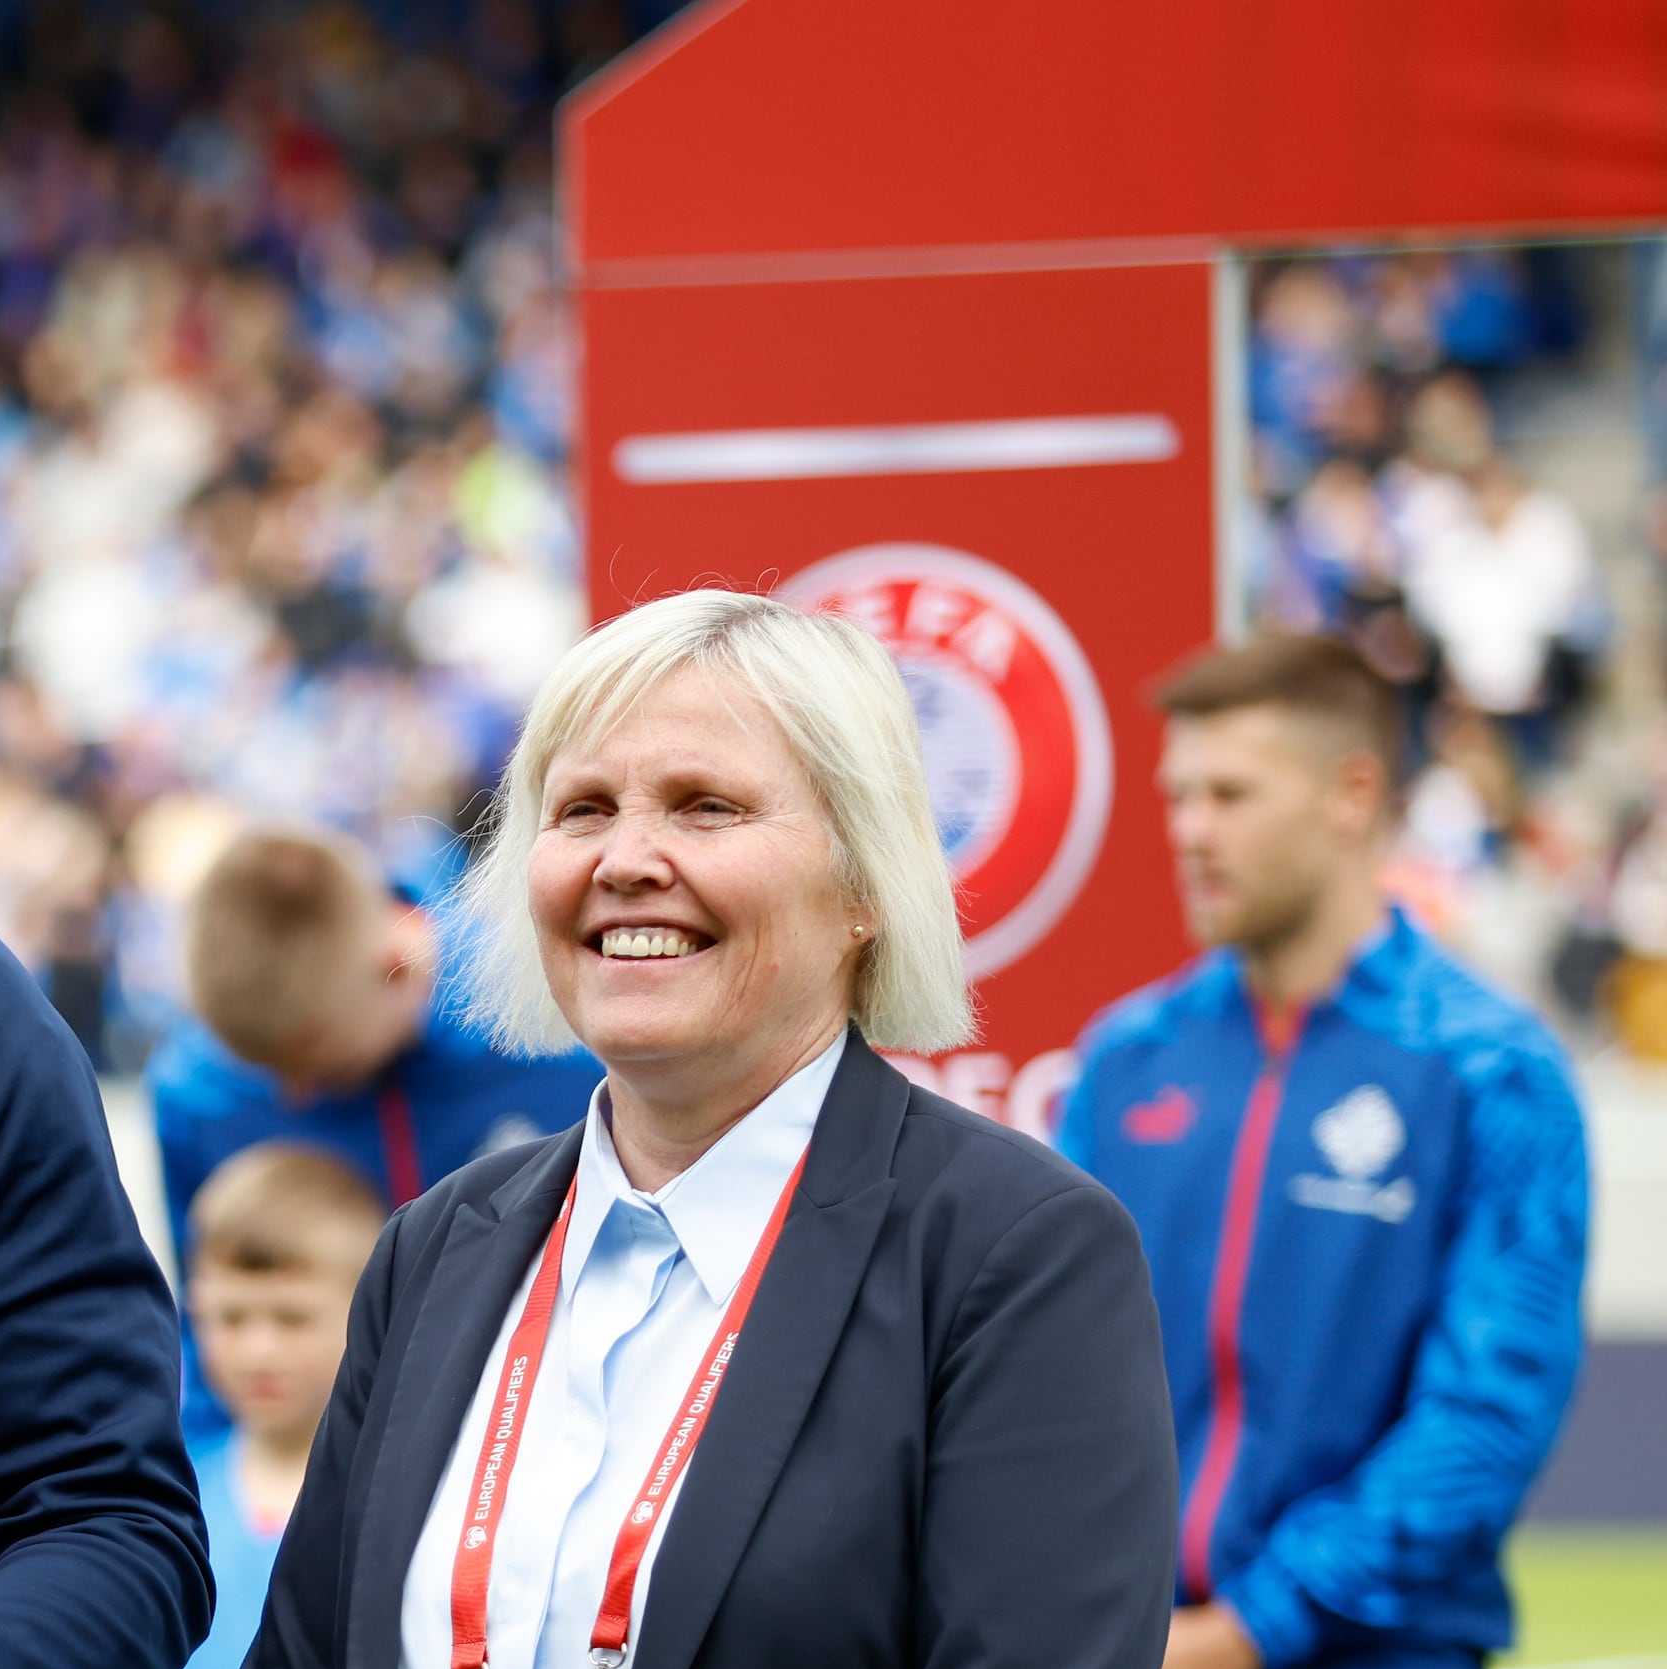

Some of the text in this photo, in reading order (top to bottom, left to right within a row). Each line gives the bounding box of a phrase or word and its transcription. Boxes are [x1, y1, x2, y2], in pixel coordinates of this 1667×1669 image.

[474, 1355, 528, 1521] EUROPEAN QUALIFIERS
[648, 1331, 739, 1497] EUROPEAN QUALIFIERS
